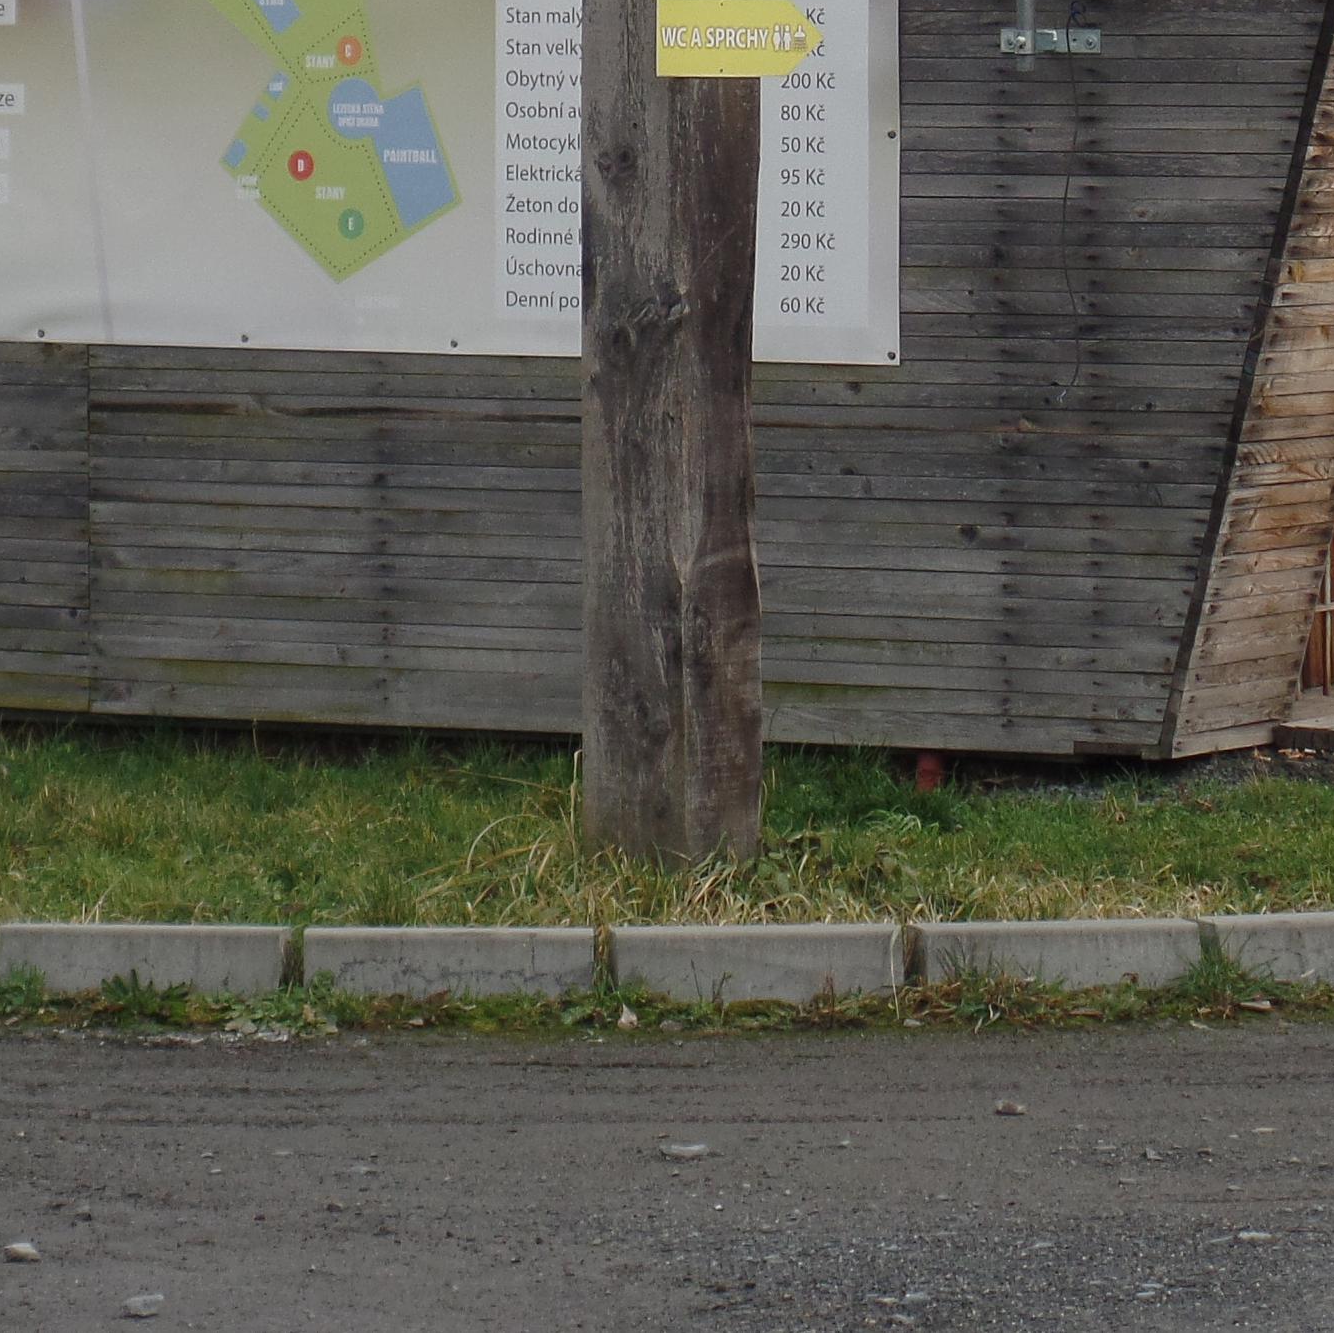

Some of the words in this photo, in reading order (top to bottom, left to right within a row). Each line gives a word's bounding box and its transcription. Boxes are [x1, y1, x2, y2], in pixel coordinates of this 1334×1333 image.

[506, 7, 541, 24] Stan
[546, 6, 583, 28] malý
[806, 8, 826, 25] Kč
[661, 26, 687, 47] WC
[690, 27, 703, 47] A
[705, 27, 769, 49] SPRCHY
[506, 38, 541, 55] Stan
[305, 54, 336, 69] STANY
[505, 69, 565, 91] Obytný
[780, 72, 812, 90] 200
[816, 72, 836, 90] Kč
[505, 101, 564, 119] Osobní
[780, 105, 801, 121] 80
[805, 104, 826, 121] Kč
[505, 132, 581, 155] Motocykl
[780, 137, 801, 154] 50
[805, 136, 826, 154] Kč
[297, 158, 305, 172] D
[382, 149, 438, 164] PAINTBALL
[505, 164, 583, 182] Elektrická
[780, 169, 801, 185] 95
[805, 168, 826, 186] Kč
[315, 186, 347, 200] STANY
[505, 193, 553, 213] Žeton
[557, 196, 579, 213] do
[780, 201, 801, 218] 20
[805, 201, 826, 218] Kč
[348, 218, 355, 231] E
[505, 227, 574, 245] Rodinné
[780, 233, 811, 249] 290
[816, 233, 836, 250] Kč
[780, 265, 801, 282] 20
[805, 265, 826, 282] Kč
[505, 290, 555, 308] Denní
[558, 295, 580, 312] po
[780, 297, 801, 313] 60
[805, 297, 826, 314] Kč
